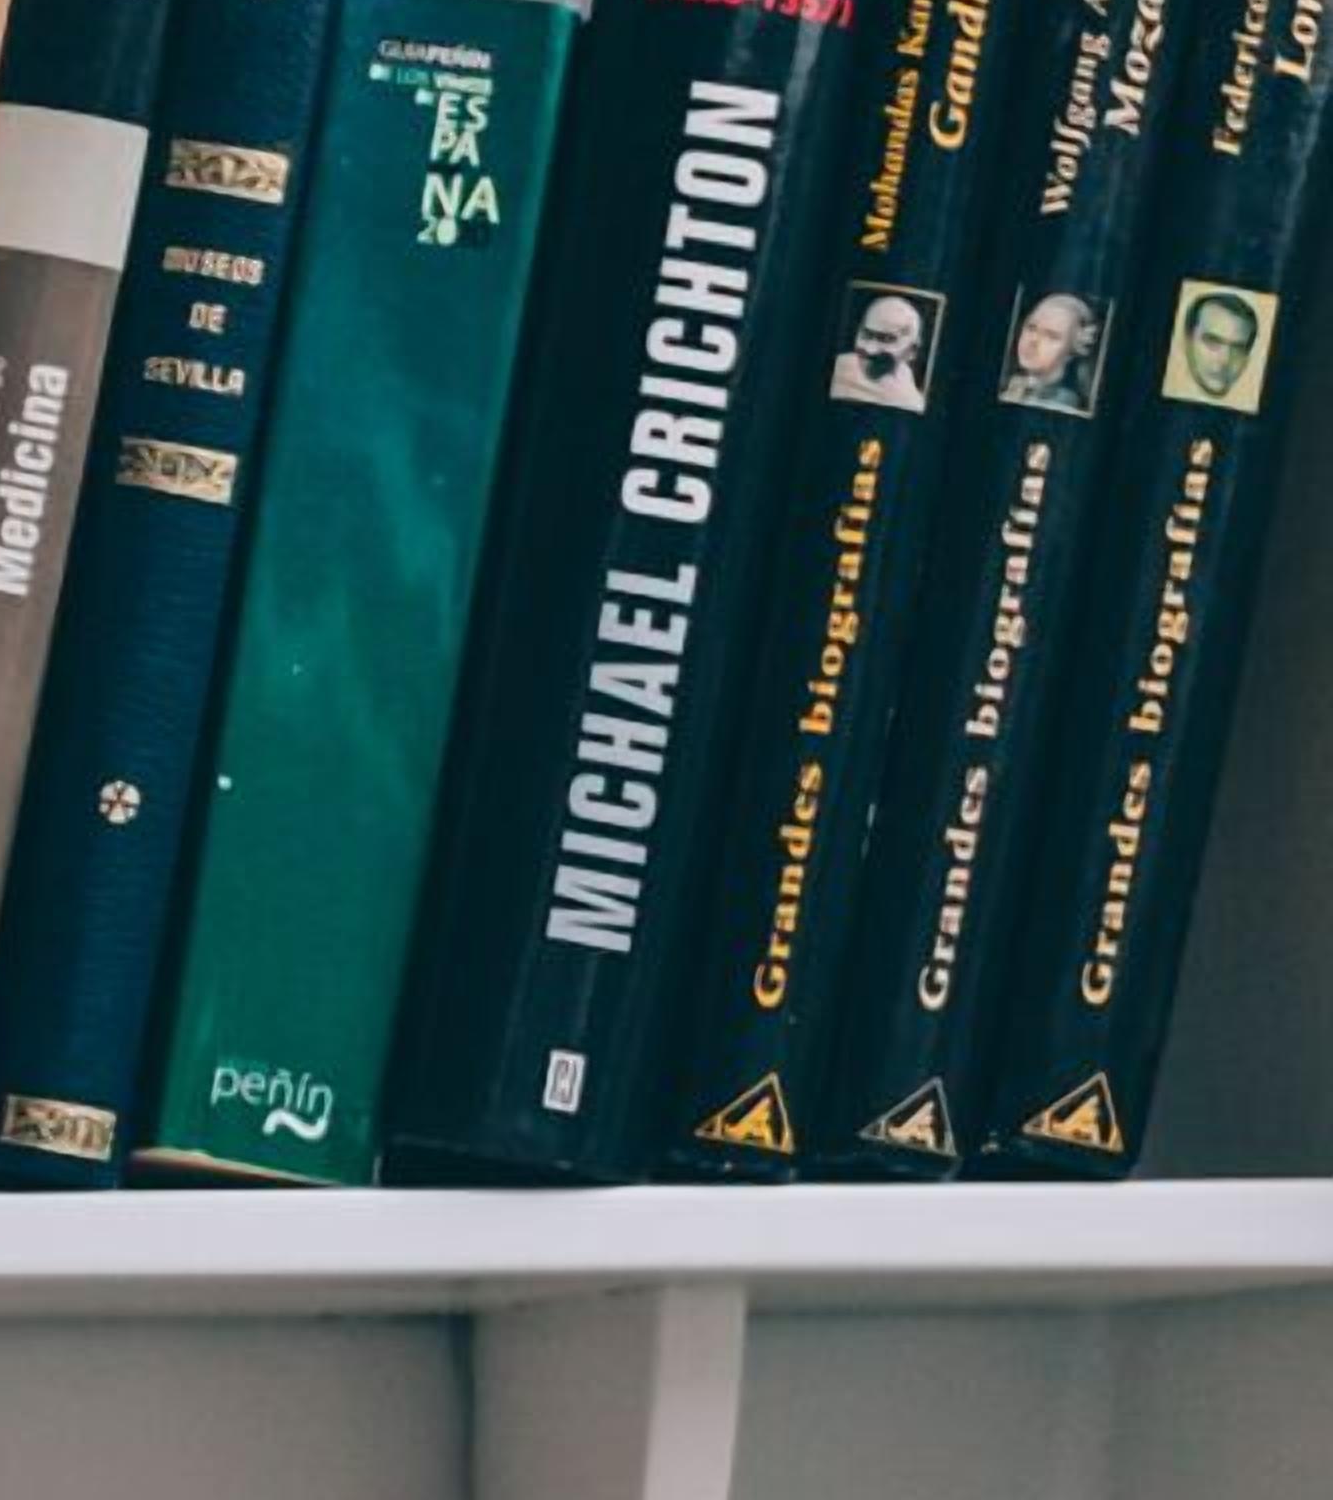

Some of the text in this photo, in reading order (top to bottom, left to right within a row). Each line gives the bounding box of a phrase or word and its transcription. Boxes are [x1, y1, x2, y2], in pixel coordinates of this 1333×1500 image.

[861, 70, 919, 249] Mohandas
[1041, 32, 1114, 213] Wolfgang
[145, 357, 245, 395] SEVILLA
[189, 302, 227, 334] DE
[546, 81, 780, 952] MICHAEL CRICHTON
[755, 764, 821, 1007] Grandes
[919, 768, 987, 1010] Grandes
[1082, 763, 1151, 1004] Grandes
